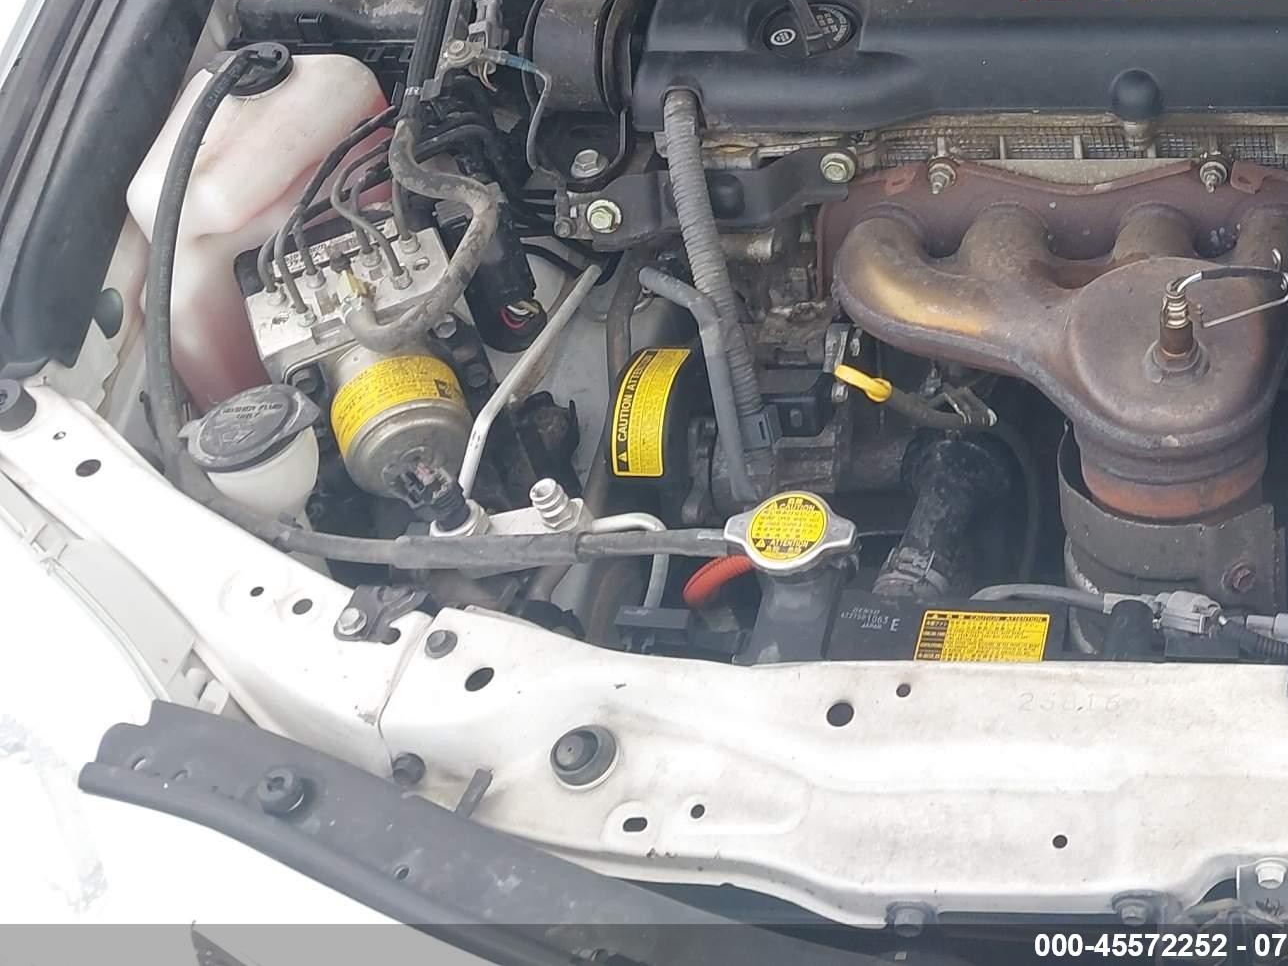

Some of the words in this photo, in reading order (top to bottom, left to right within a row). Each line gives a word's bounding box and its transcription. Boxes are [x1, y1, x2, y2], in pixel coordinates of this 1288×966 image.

[617, 393, 633, 442] CAUTION
[627, 354, 655, 391] ATTEN
[779, 503, 815, 511] CAUTION
[771, 538, 809, 548] ATTENTION
[889, 618, 900, 631] E
